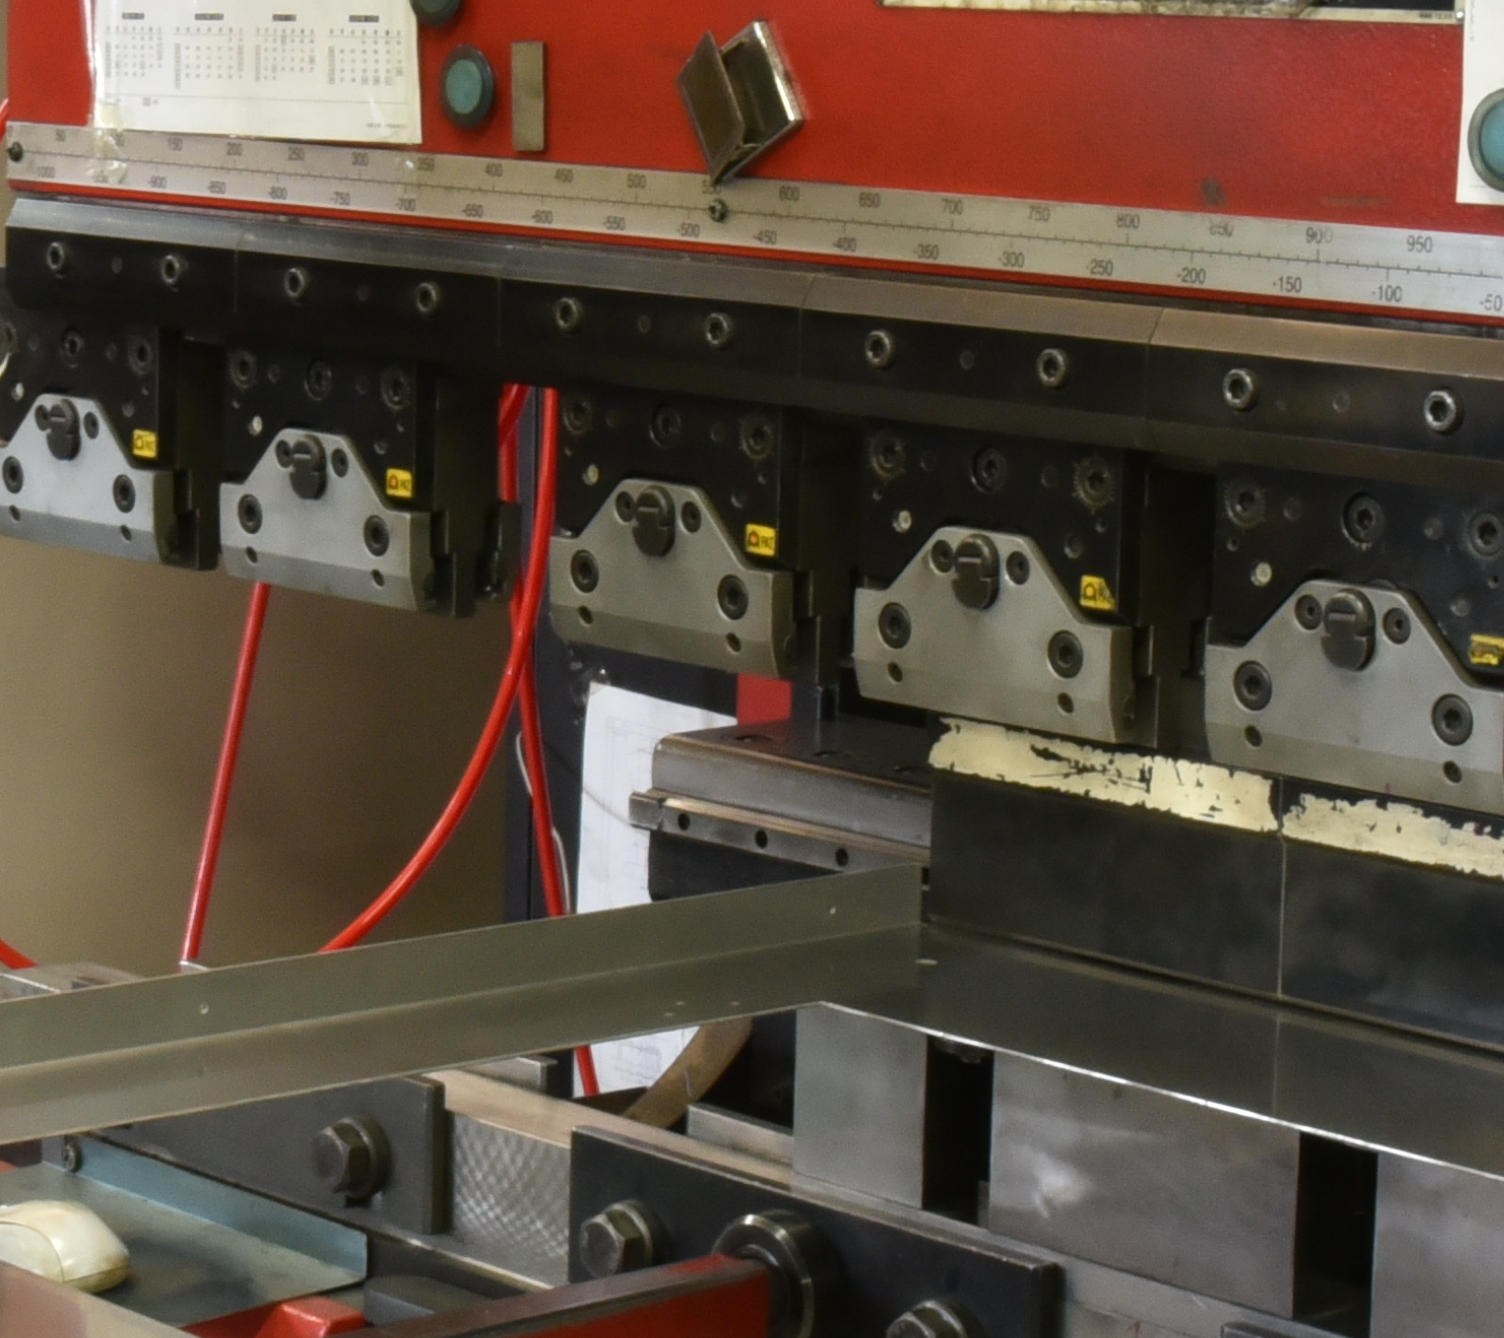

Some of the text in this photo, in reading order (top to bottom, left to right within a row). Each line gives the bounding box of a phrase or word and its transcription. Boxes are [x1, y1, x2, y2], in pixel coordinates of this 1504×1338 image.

[287, 146, 306, 163] 250
[351, 150, 370, 168] 300
[484, 161, 503, 179] 400
[554, 167, 574, 184] 450
[626, 173, 647, 190] 500
[778, 185, 800, 202] 600
[858, 192, 881, 209] 650
[941, 198, 964, 216] 700
[1027, 204, 1051, 223] 750
[1116, 212, 1141, 230] 800
[1405, 234, 1434, 255] 950
[394, 197, 417, 214] -700
[530, 208, 554, 225] -600
[602, 215, 626, 232] -550
[676, 221, 701, 239] -500
[752, 228, 778, 246] -450
[831, 235, 858, 253] -400
[912, 243, 940, 261] -350
[996, 251, 1025, 270] -300
[1086, 259, 1114, 279] -250
[1176, 267, 1207, 287] -200
[1271, 275, 1303, 295] -150
[1370, 283, 1403, 304] -100
[1478, 292, 1504, 313] -50
